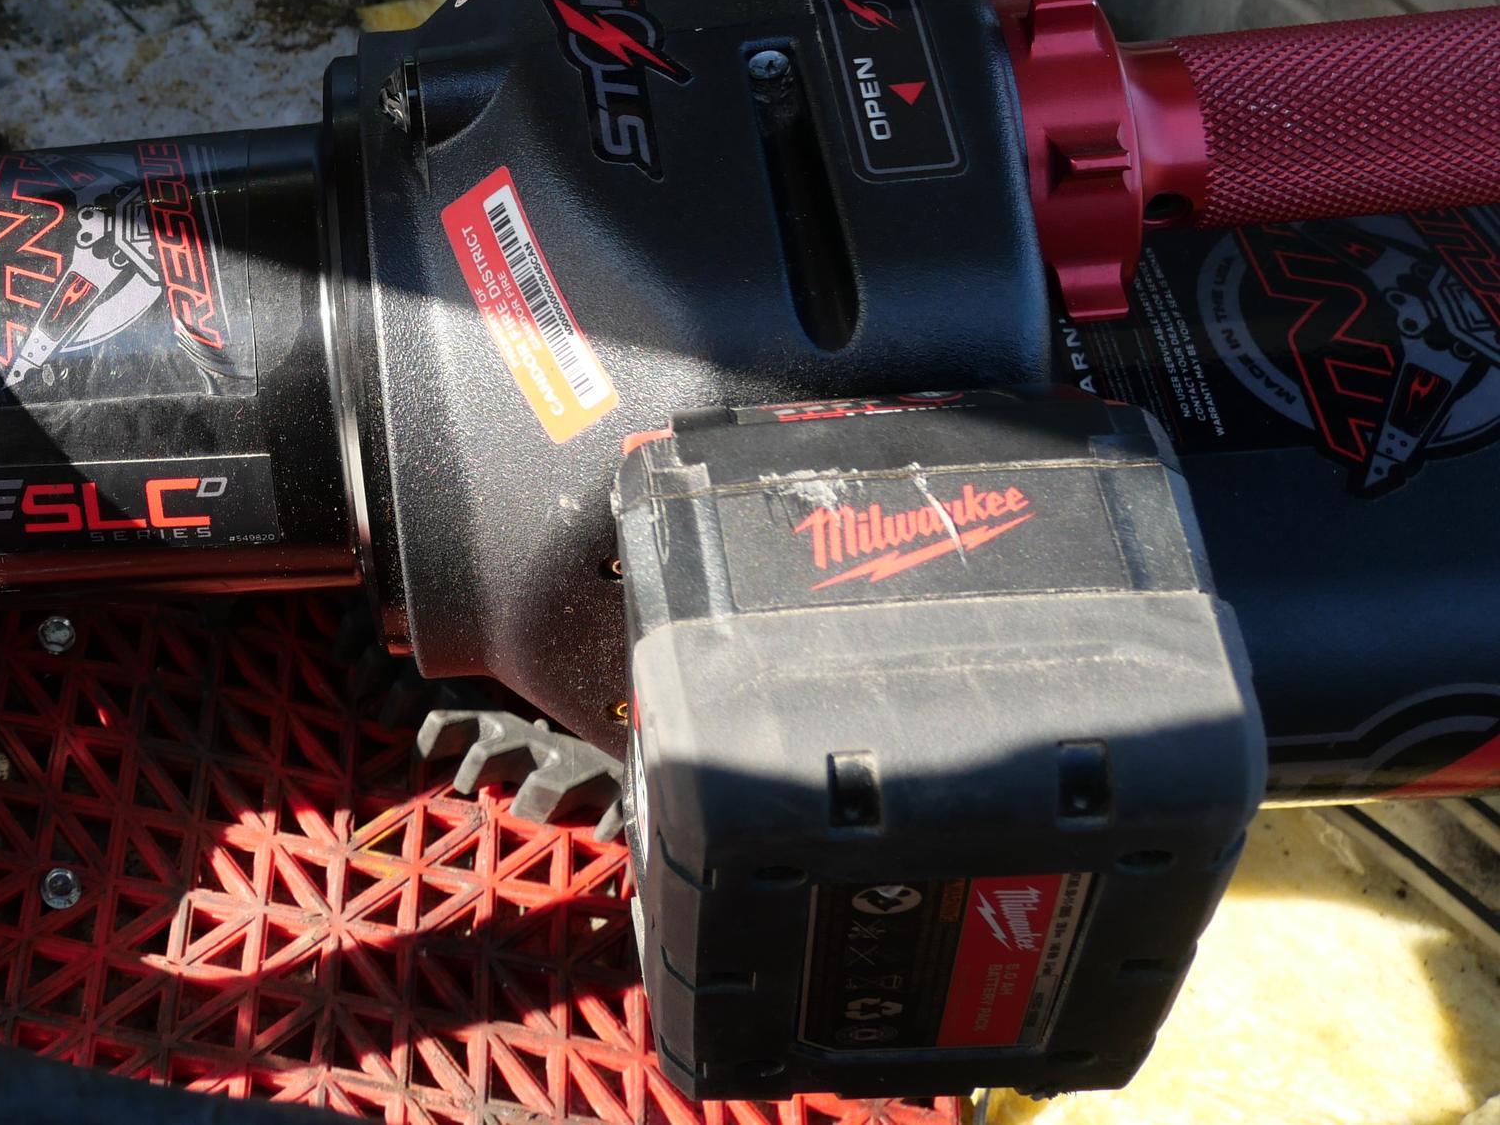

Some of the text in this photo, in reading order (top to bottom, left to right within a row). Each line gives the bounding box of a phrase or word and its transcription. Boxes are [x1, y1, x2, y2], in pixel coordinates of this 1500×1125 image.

[853, 57, 893, 141] OPEN
[138, 144, 225, 350] RESCUE
[461, 225, 501, 299] DISTRICT
[474, 288, 487, 304] OF
[497, 271, 516, 299] FIRE
[496, 300, 522, 338] FIRE
[1174, 343, 1192, 375] YOUR
[1171, 377, 1187, 402] USER
[1180, 402, 1191, 418] NO
[1184, 376, 1206, 422] CONTACT
[1202, 382, 1225, 436] WARRANTY
[91, 526, 212, 543] SERIES
[793, 483, 1030, 571] Milwaukee
[993, 885, 1043, 951] Milwaukee
